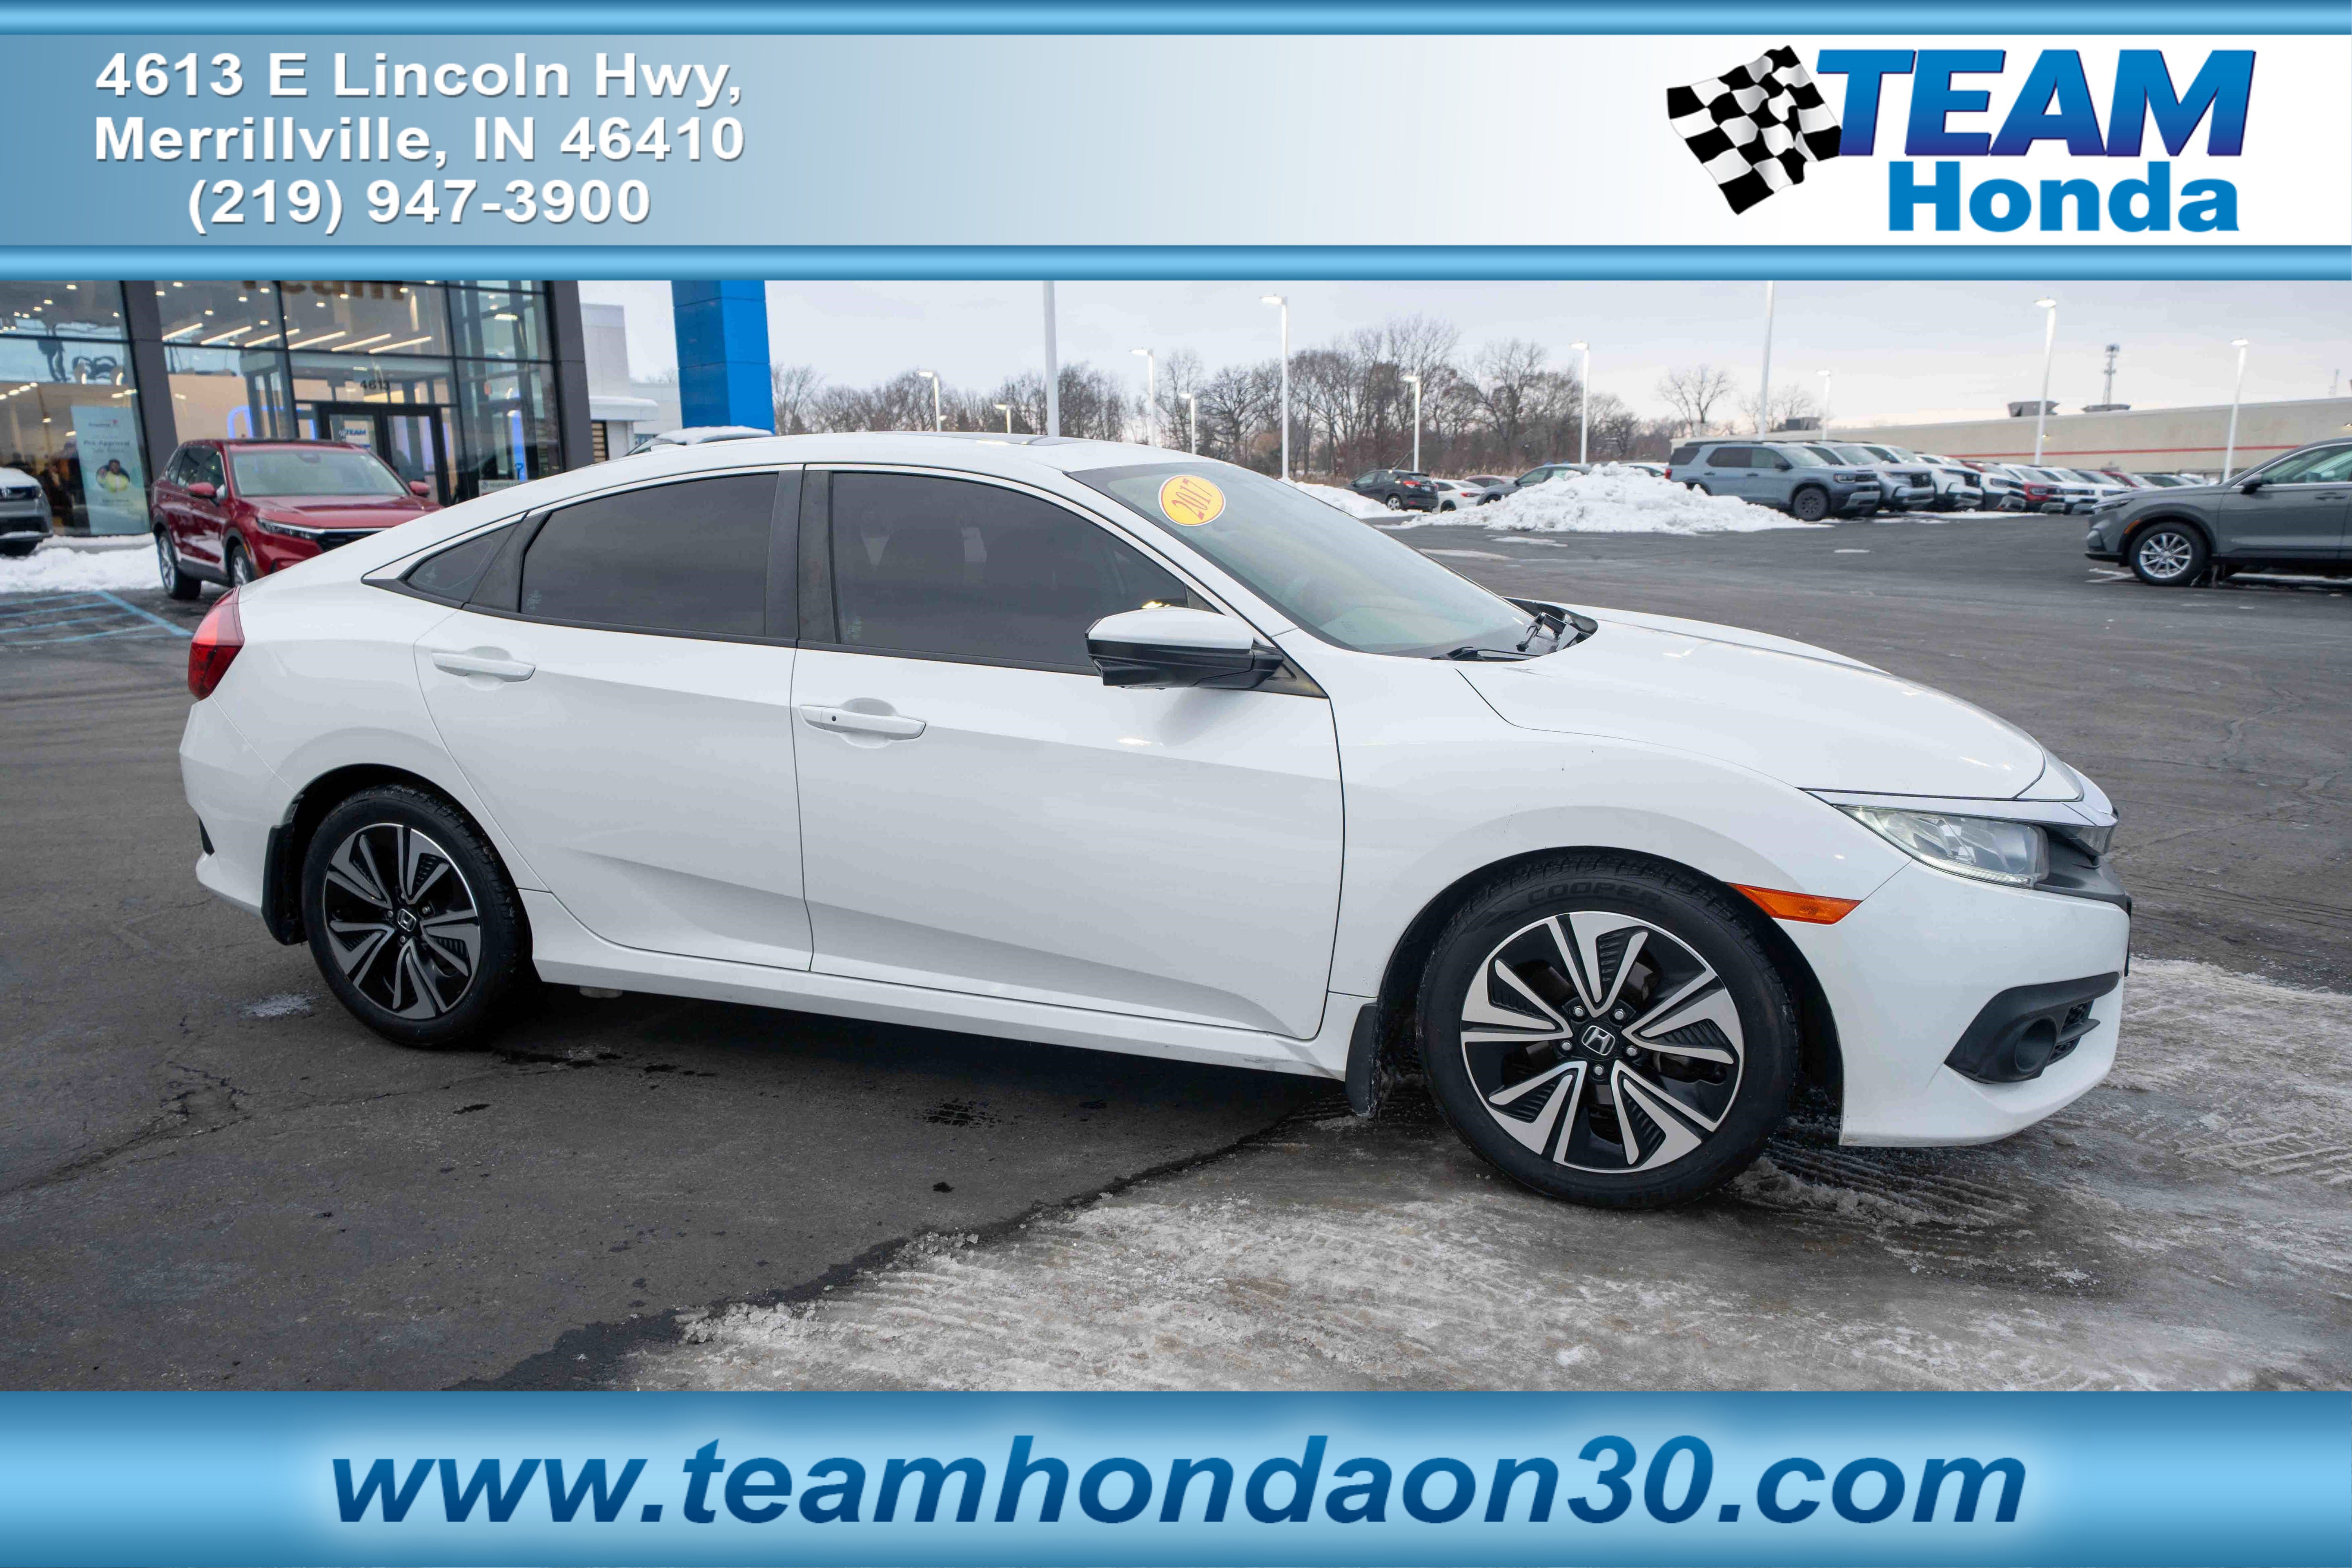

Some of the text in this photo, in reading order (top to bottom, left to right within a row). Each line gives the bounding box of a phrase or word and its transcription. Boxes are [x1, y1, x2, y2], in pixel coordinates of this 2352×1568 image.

[360, 379, 390, 390] 4613
[1171, 478, 1213, 520] 2017
[1528, 881, 1662, 904] COOPER
